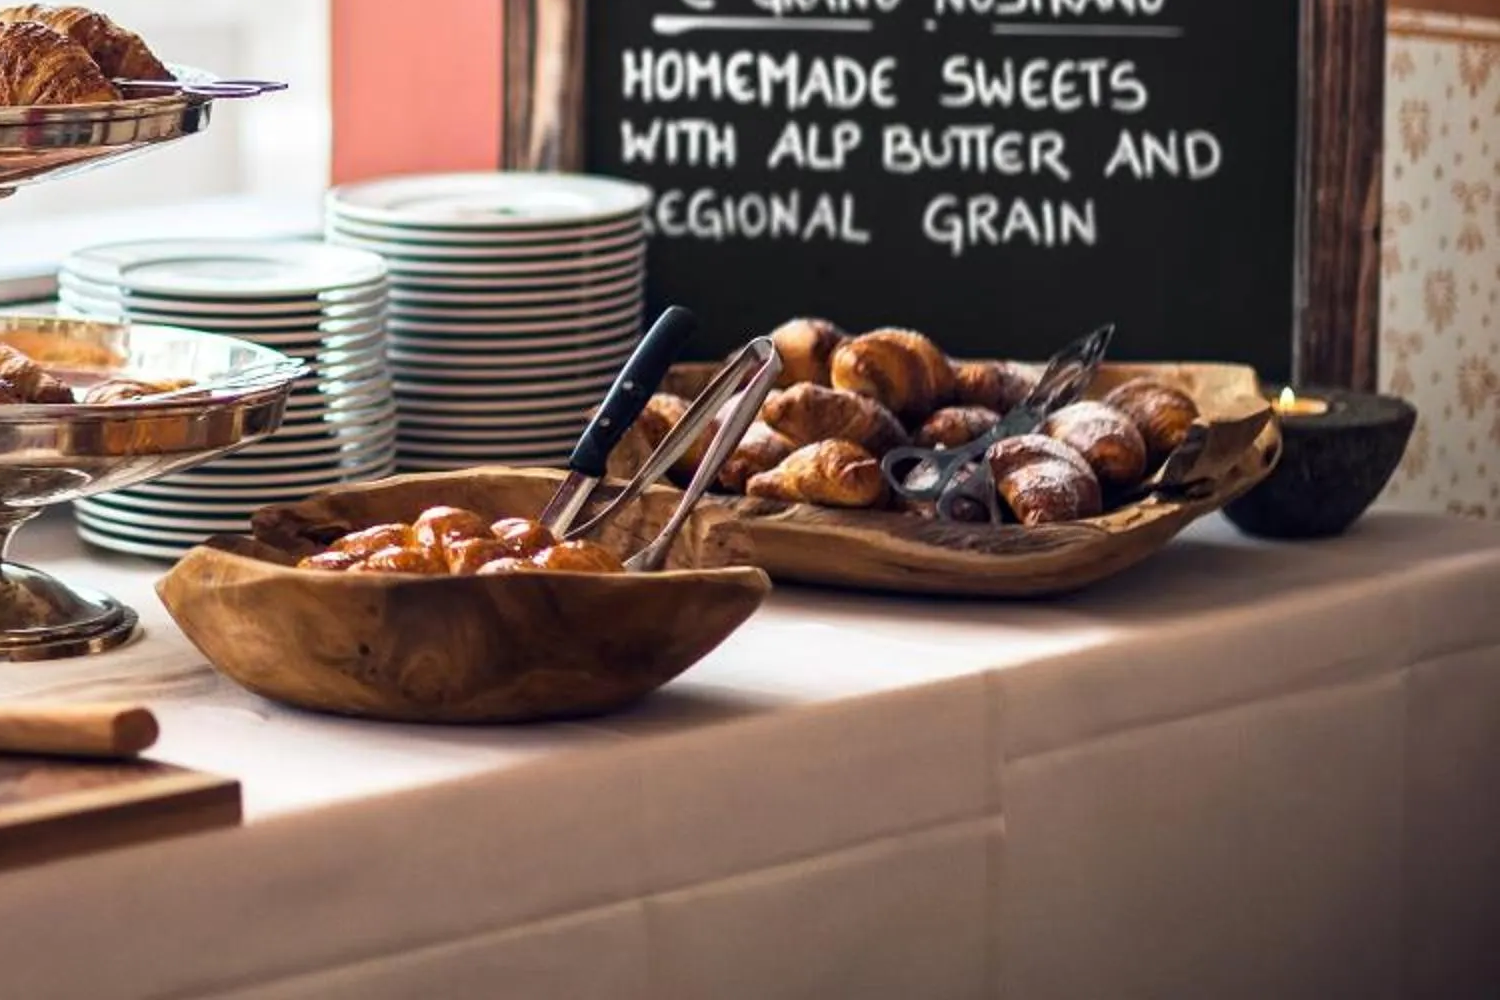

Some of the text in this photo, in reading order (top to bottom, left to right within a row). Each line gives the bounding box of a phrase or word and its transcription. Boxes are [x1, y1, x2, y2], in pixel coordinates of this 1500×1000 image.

[621, 47, 1148, 112] HOMEMADE SWEETS
[619, 118, 1222, 181] WITH ALP BUTTER AND
[922, 194, 1097, 255] GRAIN
